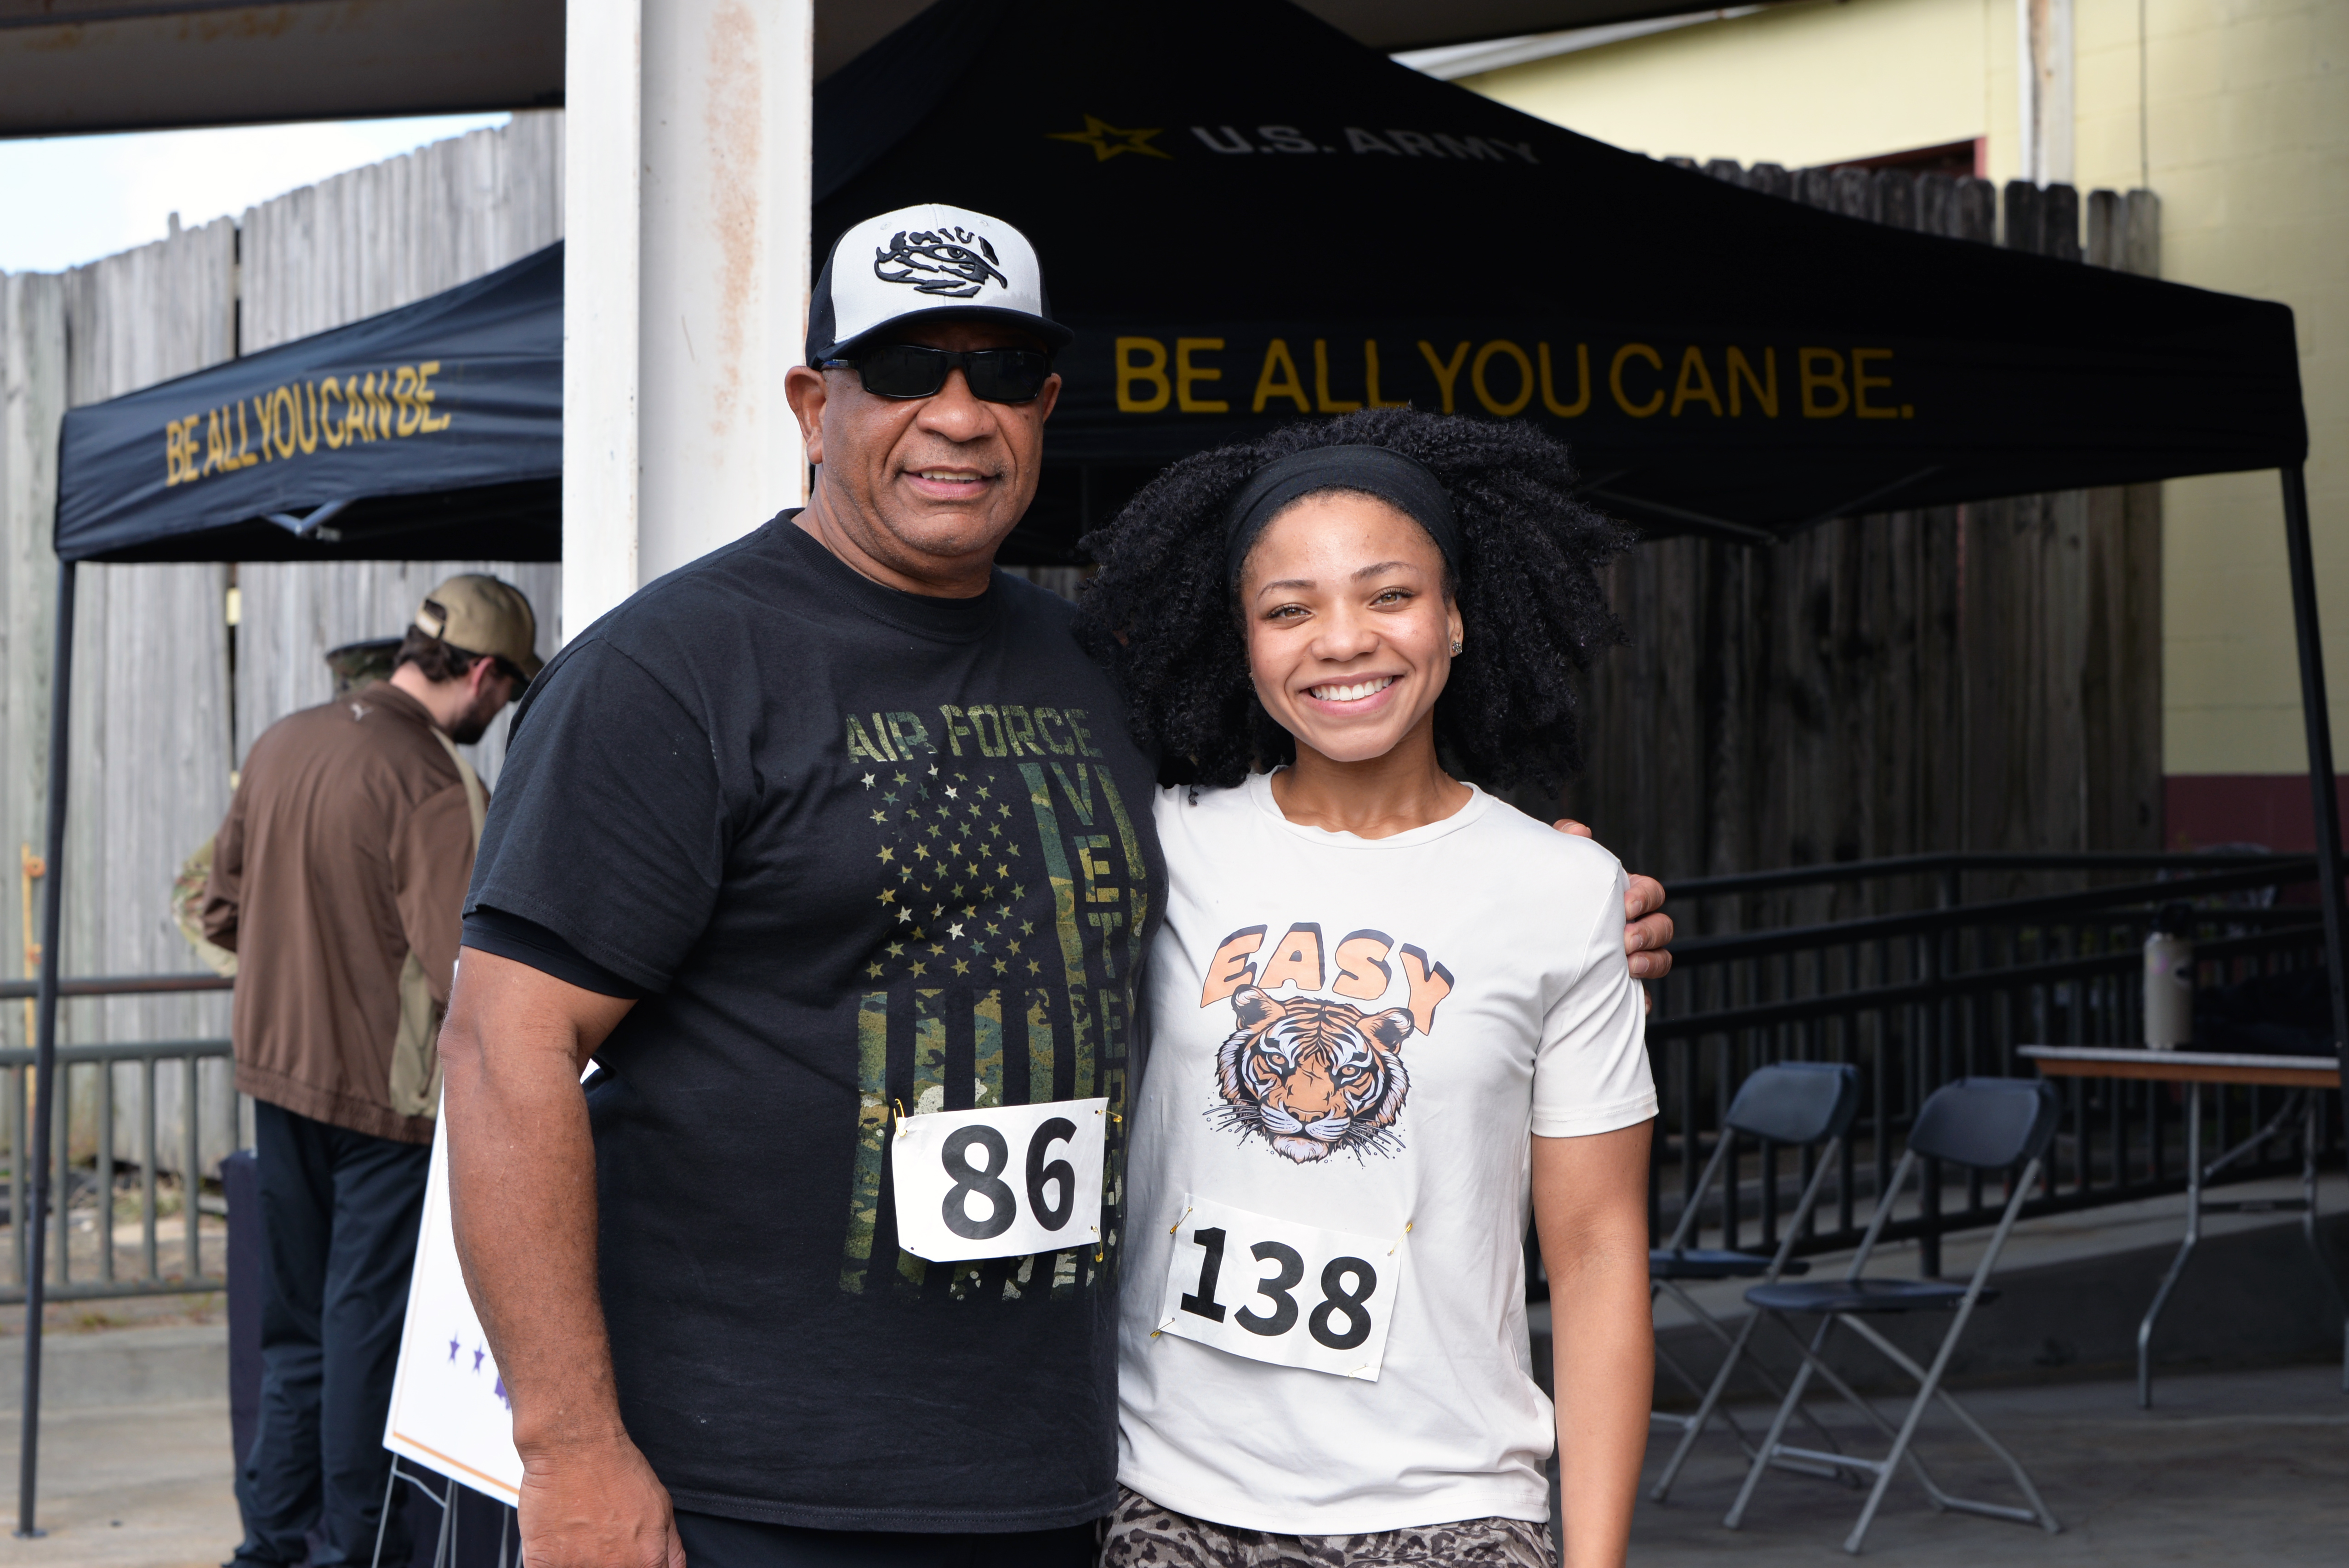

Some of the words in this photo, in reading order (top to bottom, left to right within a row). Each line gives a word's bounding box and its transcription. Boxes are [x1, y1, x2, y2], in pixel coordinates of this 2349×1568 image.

[1190, 125, 1336, 154] U.S.
[1343, 126, 1541, 164] ARMY
[166, 415, 199, 487] BE
[203, 400, 258, 477] ALL
[254, 380, 318, 462] YOU
[321, 369, 391, 449] CAN
[392, 360, 451, 437] BE.
[1115, 336, 1229, 413] BE
[1251, 338, 1412, 413] ALL
[1418, 339, 1591, 419] YOU
[1610, 343, 1778, 419] CAN
[1799, 347, 1914, 421] BE.
[847, 711, 938, 764] AIR
[938, 704, 1103, 758] FORCE
[1200, 922, 1454, 1036] EASY
[942, 1117, 1077, 1240] 86
[1180, 1227, 1376, 1350] 138
